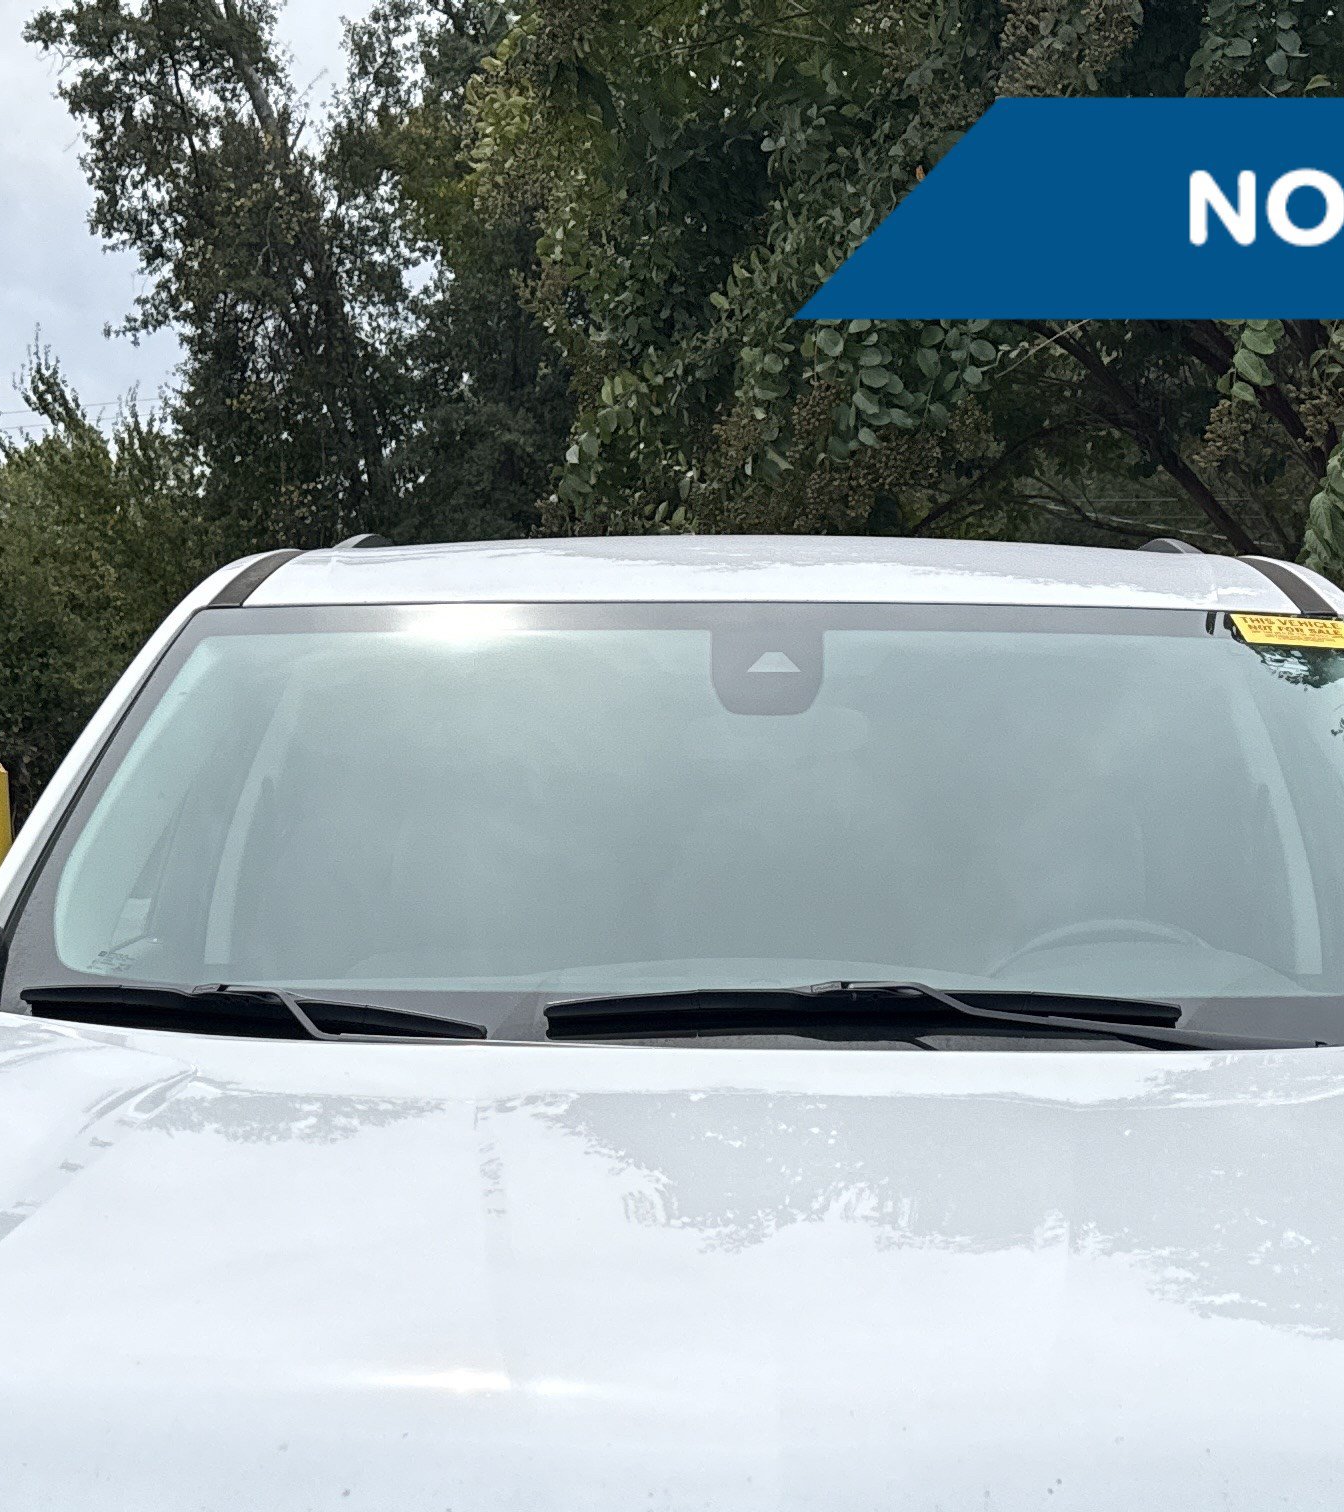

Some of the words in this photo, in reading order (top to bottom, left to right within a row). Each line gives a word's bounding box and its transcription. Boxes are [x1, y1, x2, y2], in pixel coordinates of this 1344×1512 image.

[1239, 616, 1275, 625] THIS
[1277, 618, 1340, 630] VEHICLE
[1248, 624, 1273, 632] NOT
[1277, 626, 1305, 634] FOR
[1308, 628, 1341, 636] SALE
